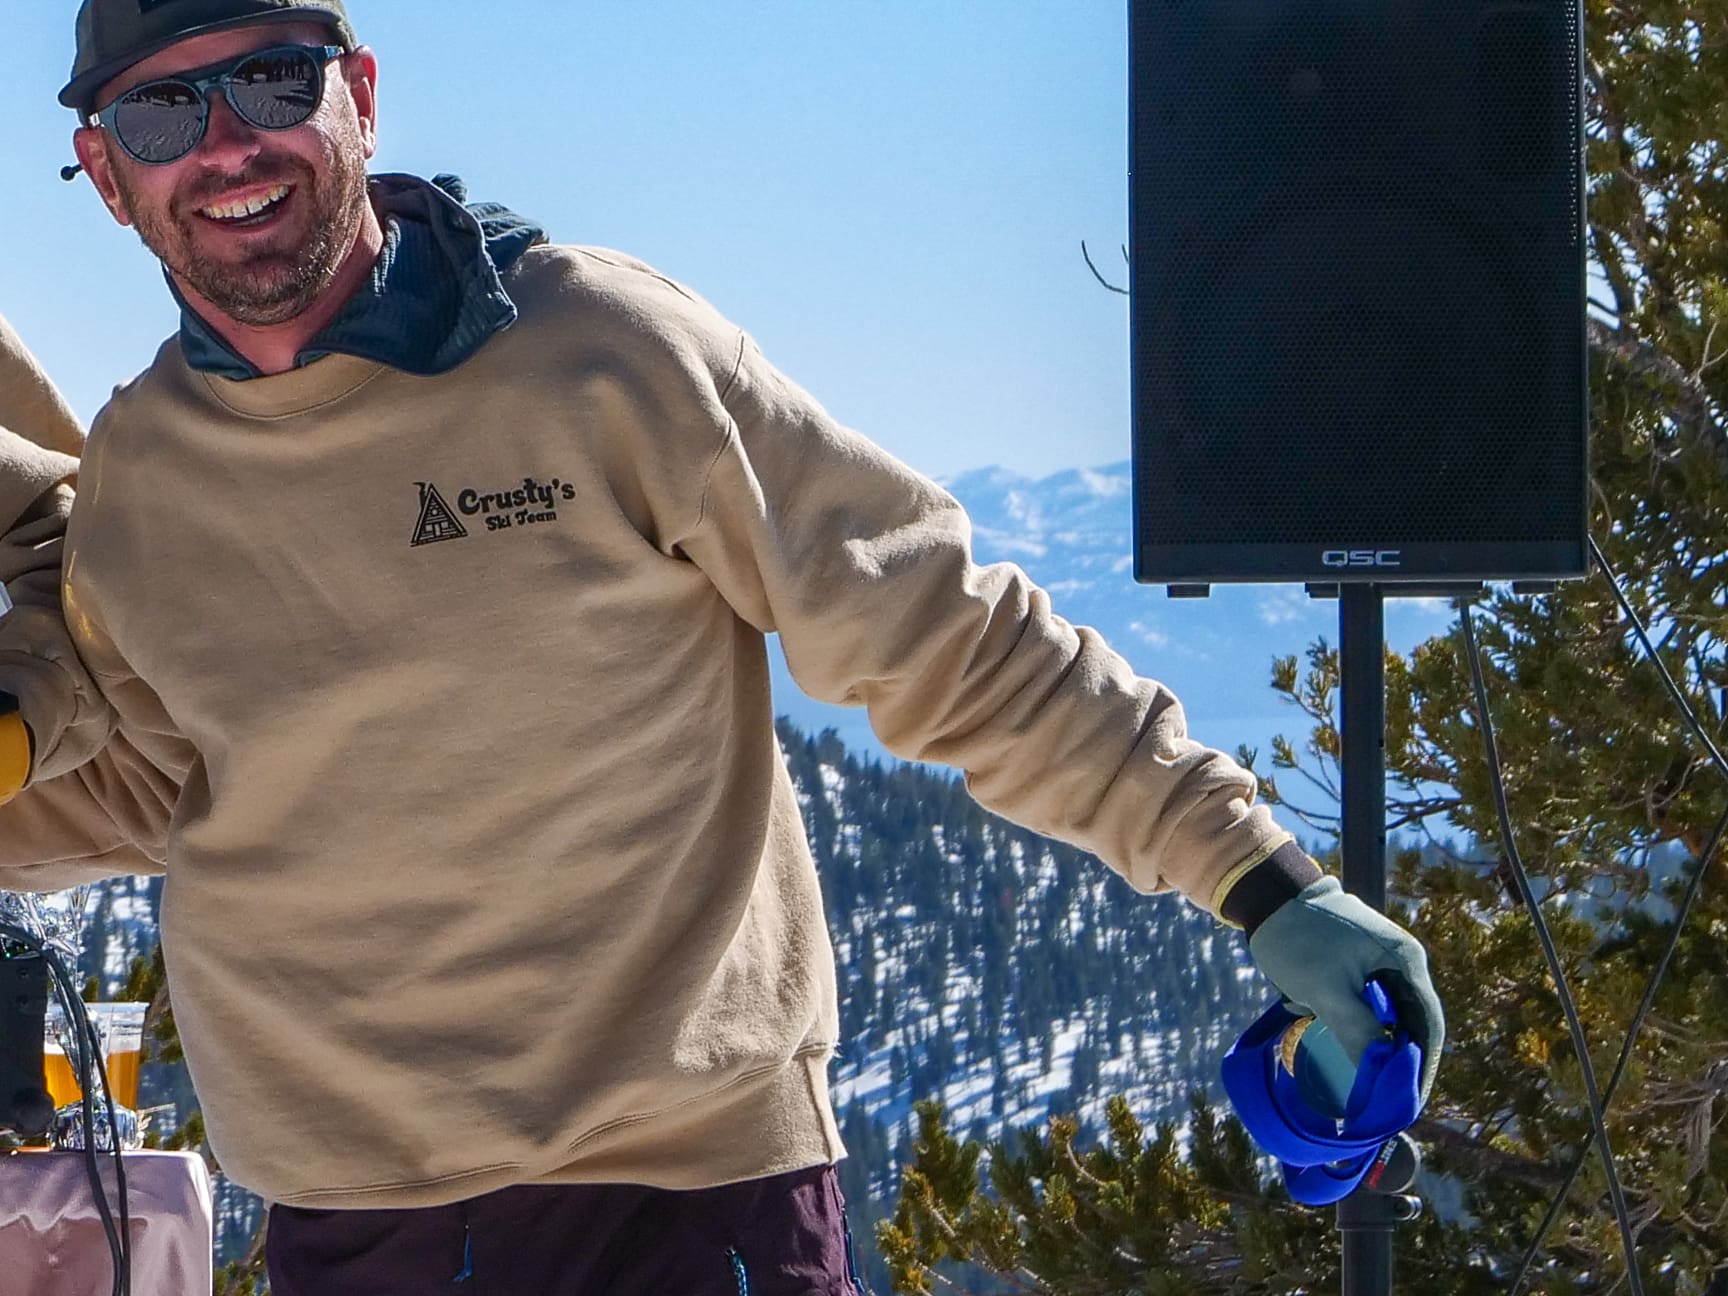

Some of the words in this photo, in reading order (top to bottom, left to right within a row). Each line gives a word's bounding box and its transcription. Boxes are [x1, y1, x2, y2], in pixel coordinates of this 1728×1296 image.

[458, 478, 576, 515] Crusty's
[485, 515, 511, 531] Ski
[515, 509, 557, 525] Team
[1322, 550, 1401, 567] QSC
